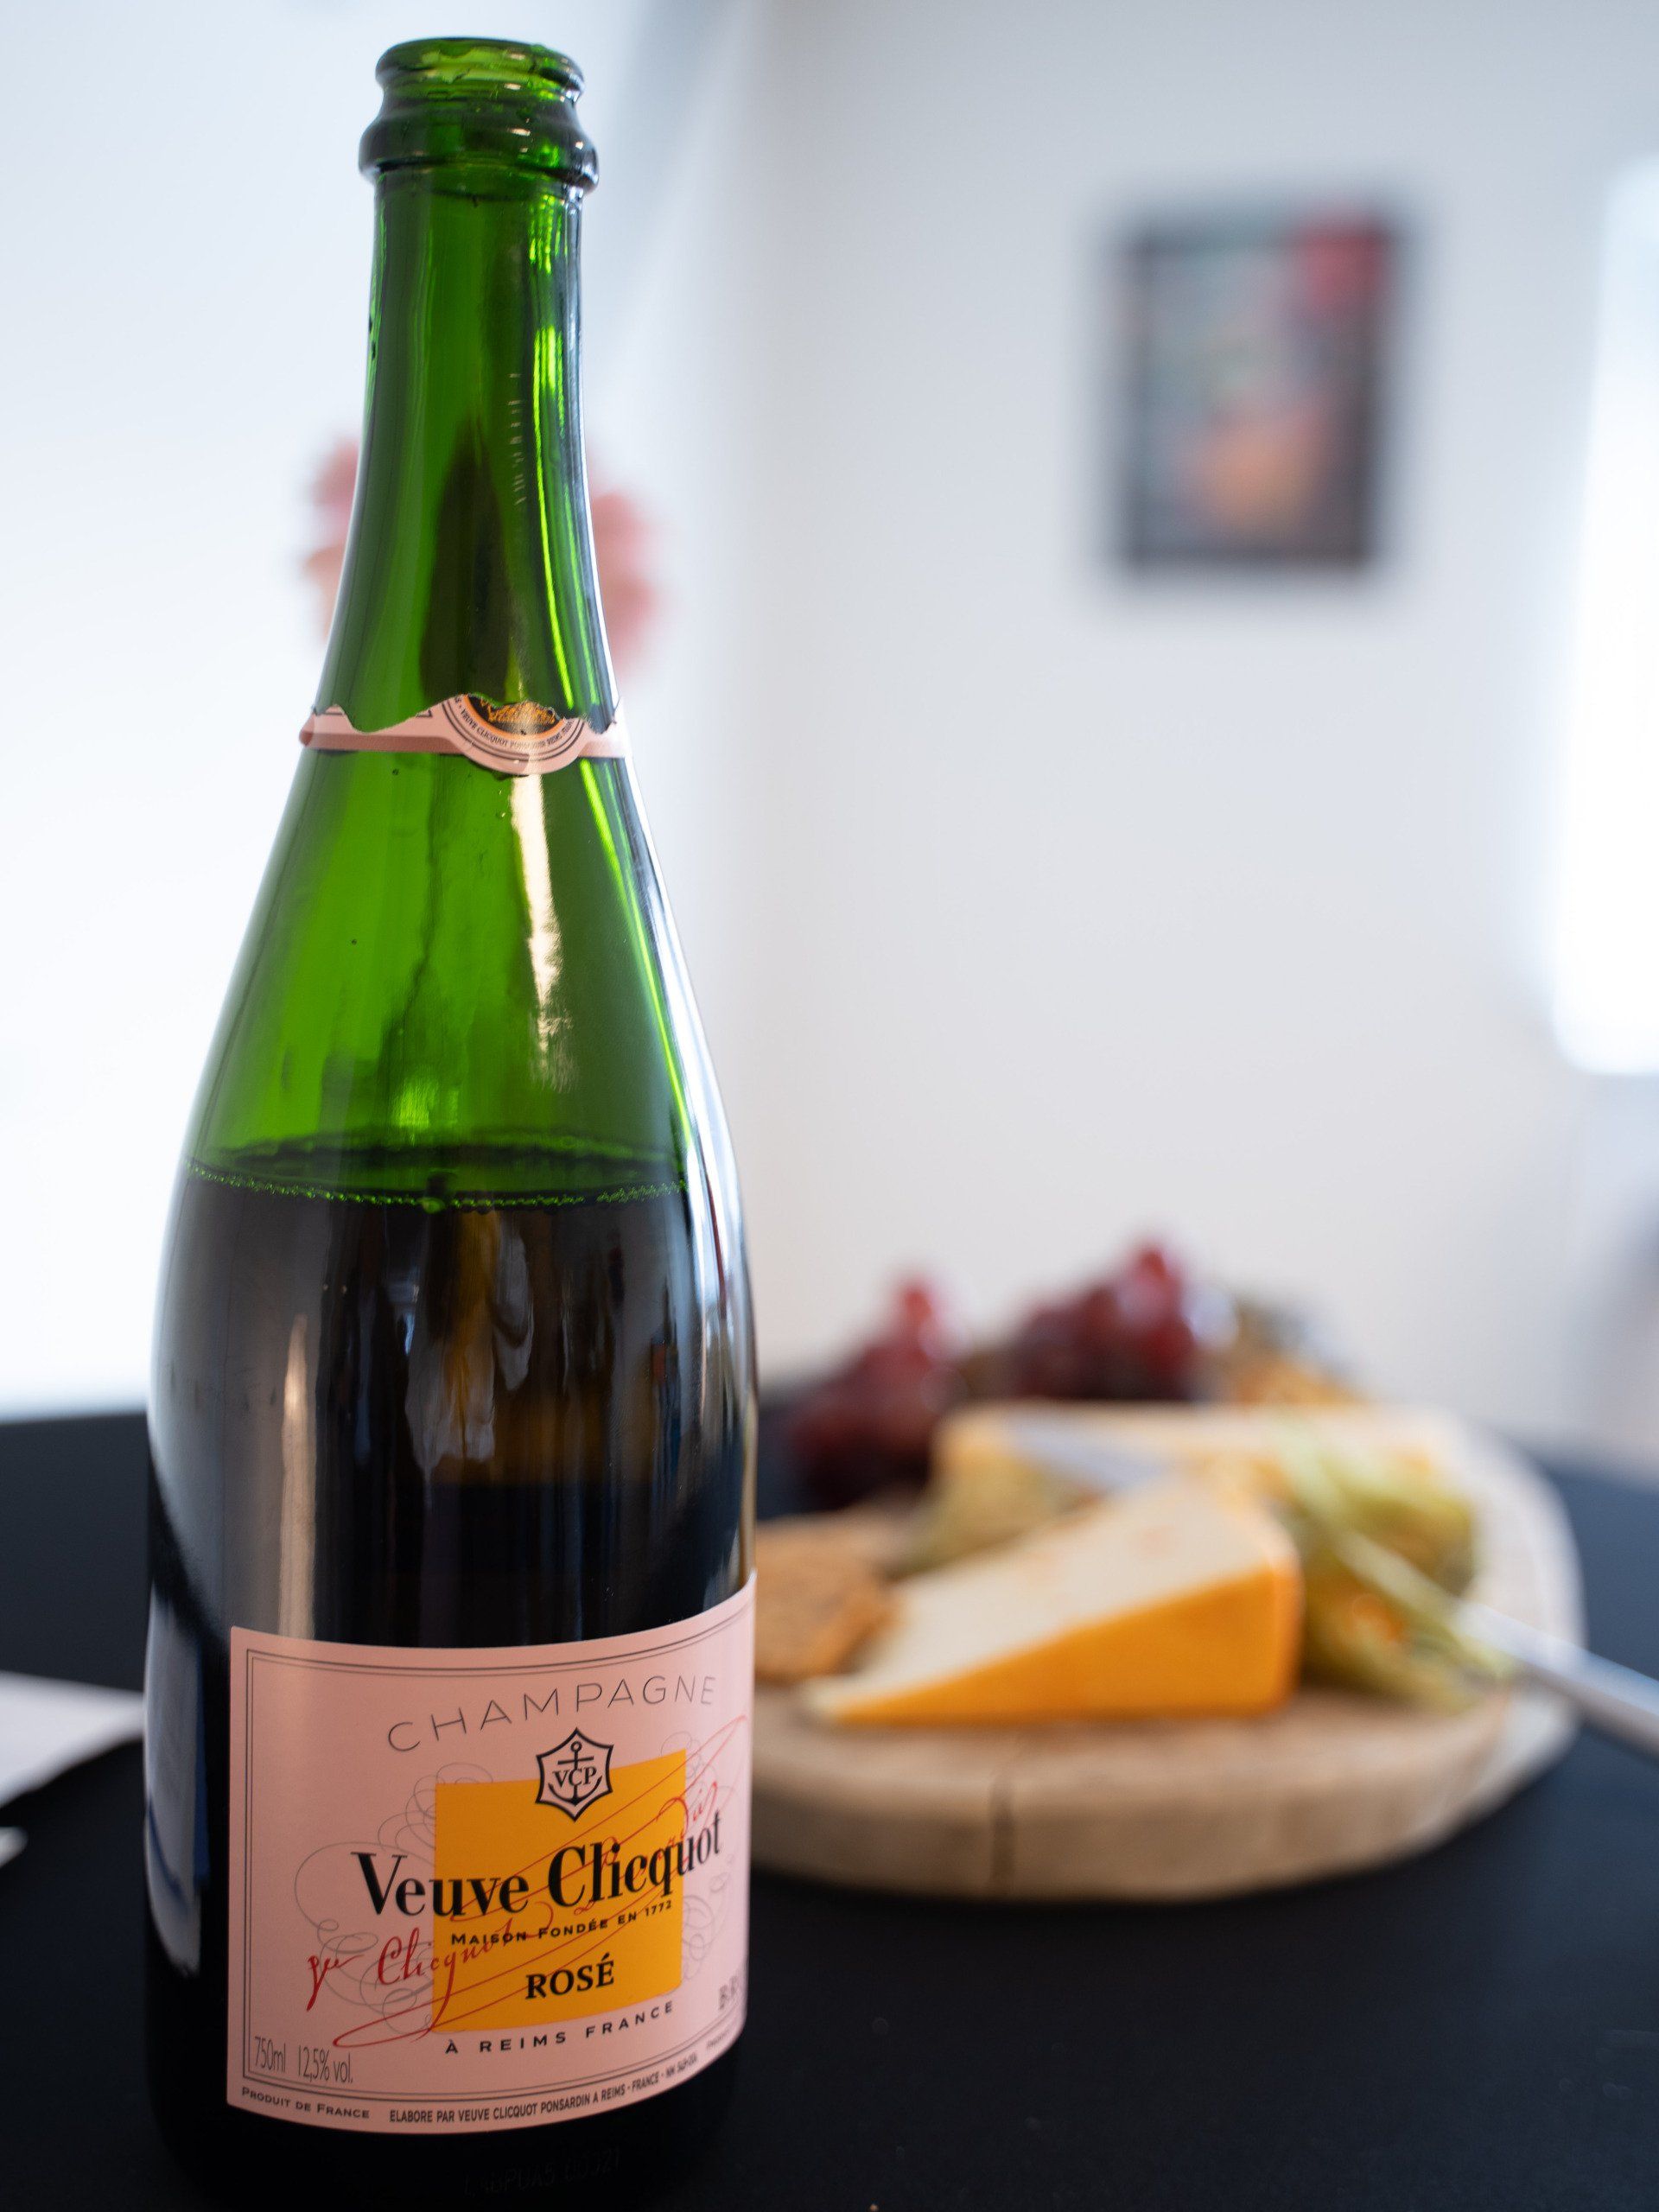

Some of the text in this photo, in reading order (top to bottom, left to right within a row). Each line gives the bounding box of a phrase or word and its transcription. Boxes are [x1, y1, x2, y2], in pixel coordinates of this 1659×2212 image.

[387, 1675, 716, 1752] CHAMPAGNE
[553, 1764, 598, 1789] VCP
[350, 1851, 529, 1916] Veuve
[548, 1810, 722, 1909] Clicquot
[451, 1931, 527, 1945] MAISON
[618, 1911, 637, 1925] EN
[645, 1900, 672, 1916] 1772
[525, 1952, 615, 2000] ROSÉ
[445, 2001, 674, 2054] À REIMS FRANCE
[254, 2036, 286, 2073] 750ml
[334, 2053, 353, 2083] vol.
[241, 2087, 370, 2120] PRODUIT DE FRANCE
[389, 2108, 433, 2123] ELABORE
[436, 2109, 455, 2123] PAR
[459, 2107, 490, 2121] VEUVE
[493, 2102, 537, 2120] CLICQUOT
[540, 2093, 590, 2114] PONSARDIN
[601, 2084, 626, 2101] REIMS
[632, 2070, 659, 2092] FRANCE
